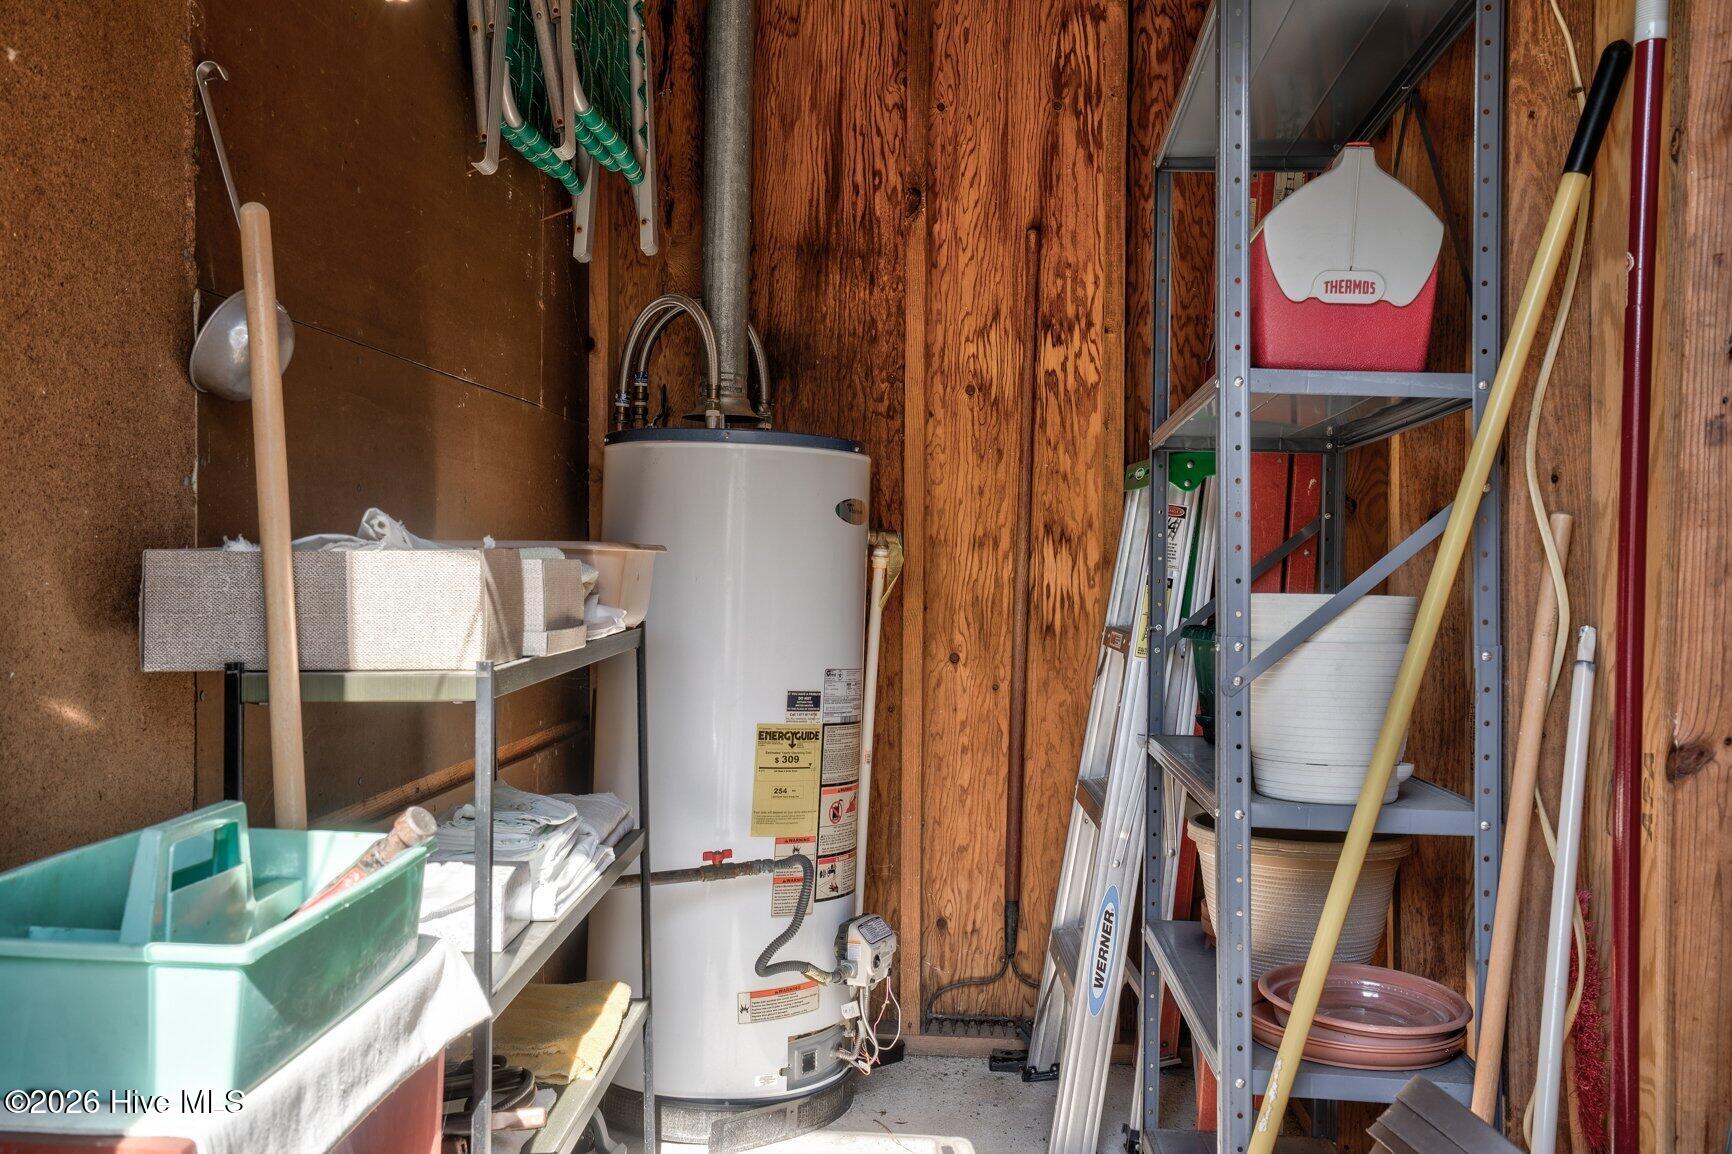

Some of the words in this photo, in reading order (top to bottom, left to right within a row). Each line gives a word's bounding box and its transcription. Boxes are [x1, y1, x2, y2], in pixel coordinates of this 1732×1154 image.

[1323, 279, 1376, 295] THERMOS
[758, 730, 820, 743] ENERGYGUIDE
[781, 755, 800, 764] 309
[1093, 908, 1115, 989] WERNER
